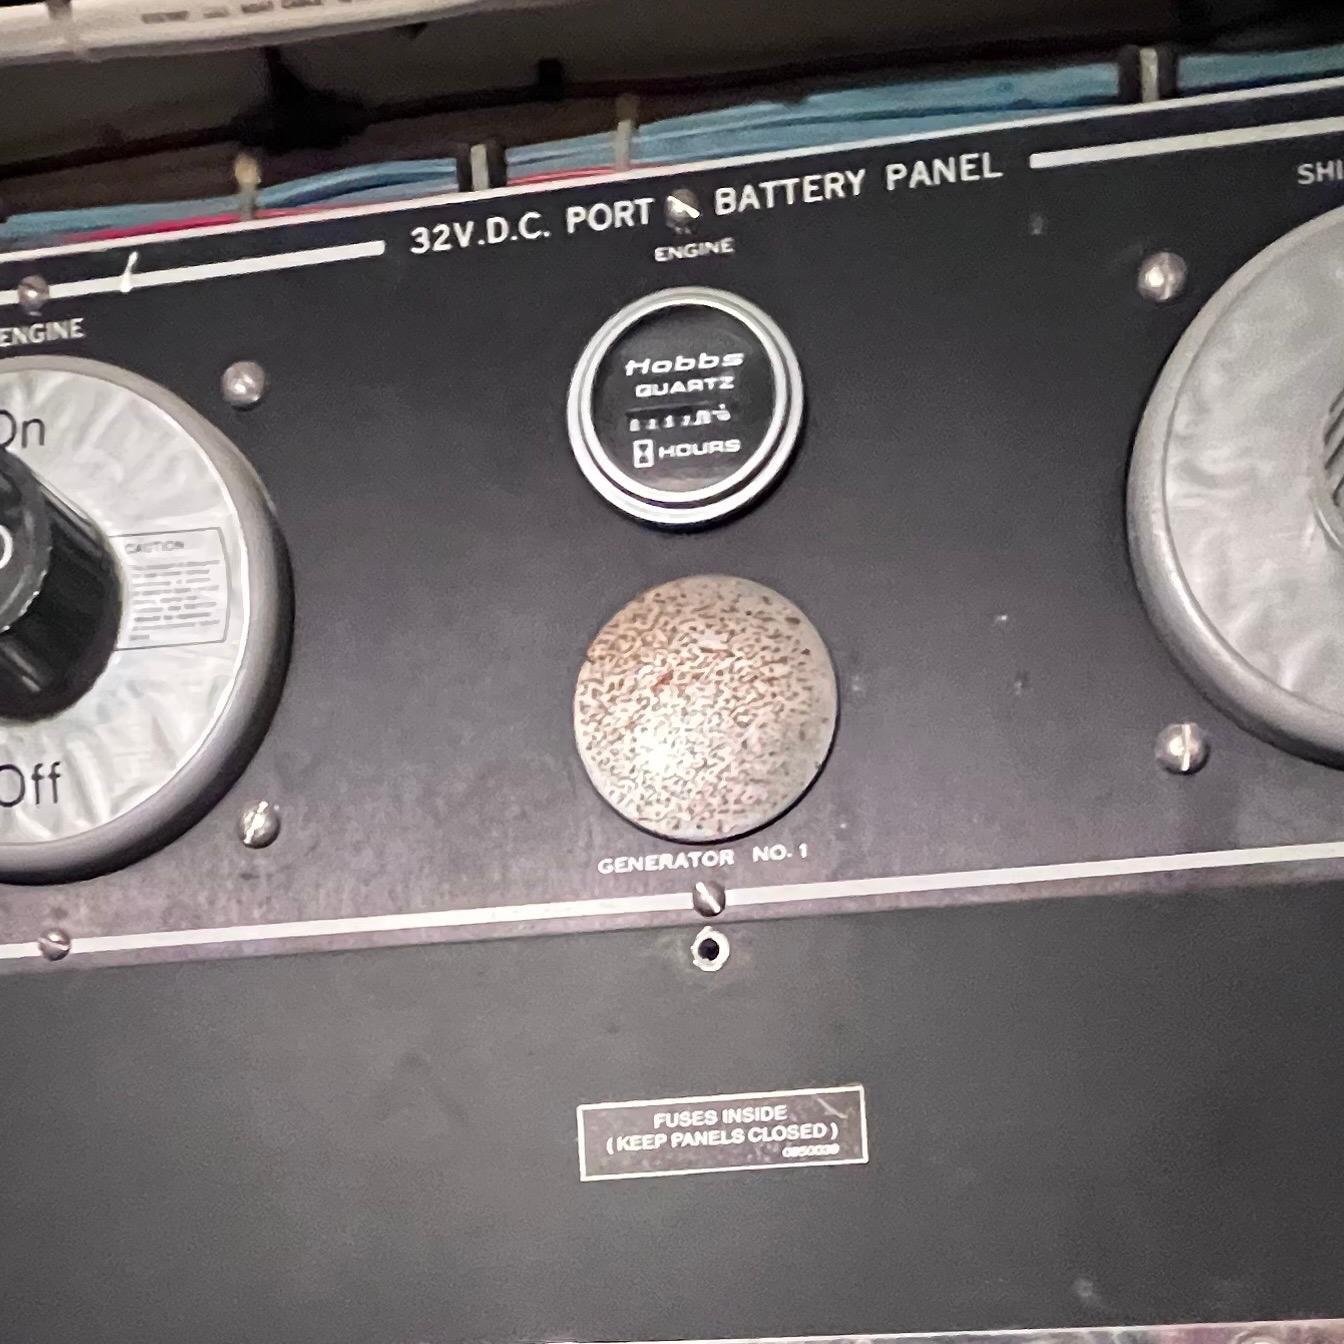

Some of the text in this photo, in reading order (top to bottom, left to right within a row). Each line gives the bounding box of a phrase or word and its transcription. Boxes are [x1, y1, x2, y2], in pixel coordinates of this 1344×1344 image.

[410, 151, 1003, 254] 32V.D.C. PORT BATTERY PANEL
[654, 237, 735, 262] ENGINE
[625, 353, 744, 376] Hobbs
[635, 376, 735, 397] QUARTZ
[659, 439, 741, 460] HOURS
[597, 843, 808, 875] GENERATOR NO. 1
[653, 1105, 788, 1129] FUSES INSIDE
[671, 1127, 746, 1148] PANELS
